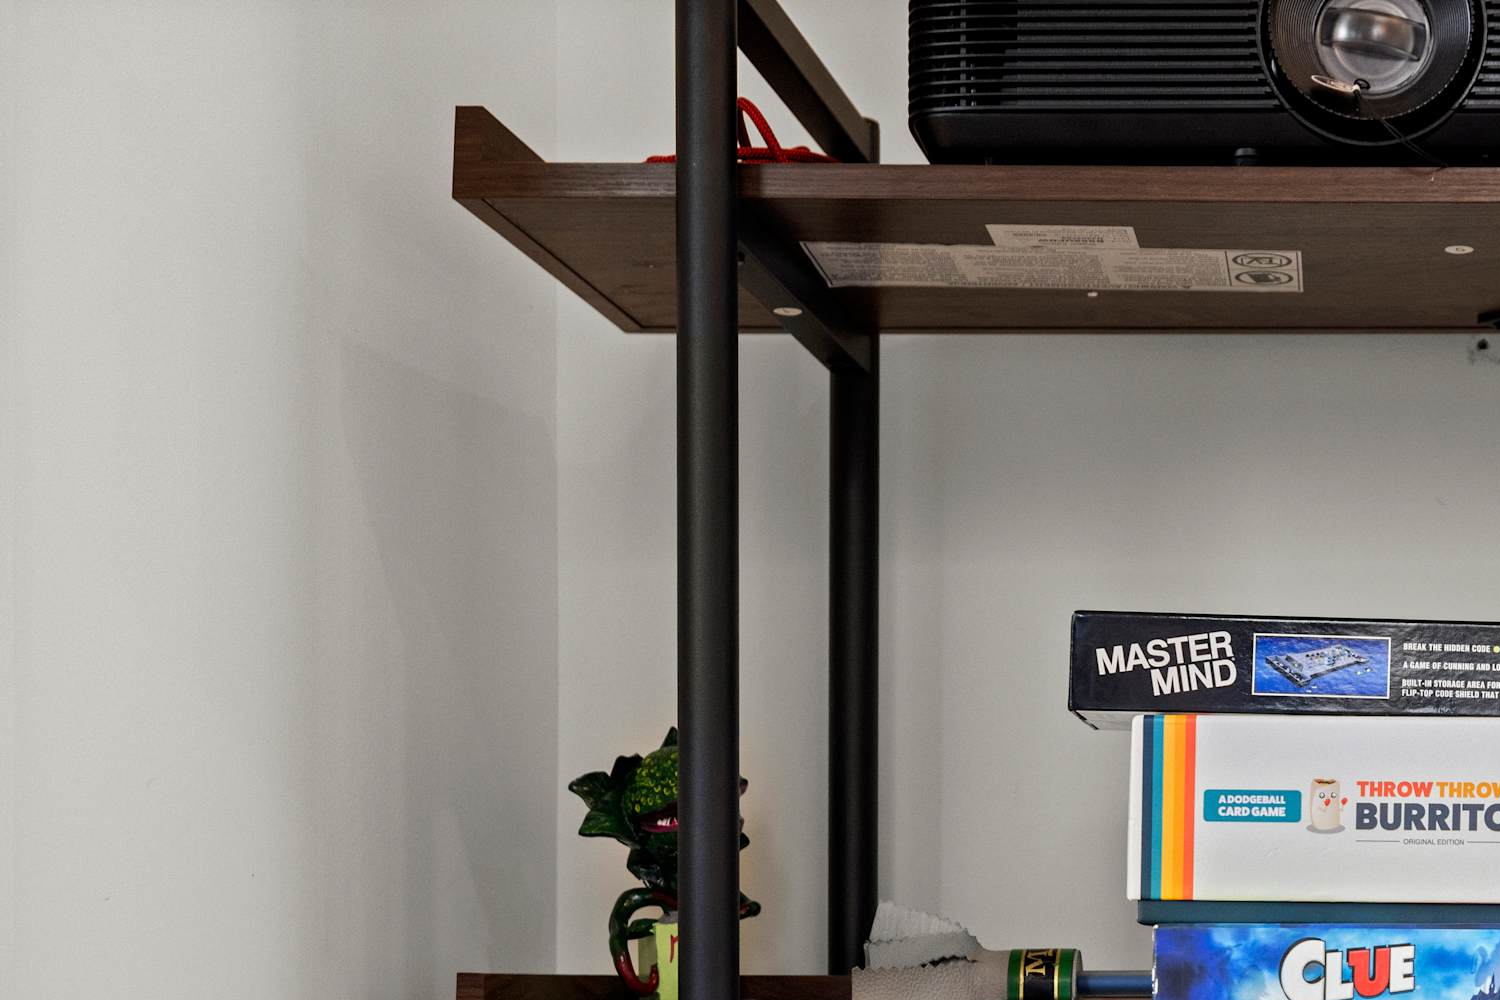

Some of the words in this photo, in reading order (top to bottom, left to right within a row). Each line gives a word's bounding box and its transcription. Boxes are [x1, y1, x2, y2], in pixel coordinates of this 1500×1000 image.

[1095, 630, 1233, 676] MASTER
[1403, 643, 1426, 651] BREAK
[1443, 644, 1470, 652] HIDDEN
[1472, 644, 1490, 653] CODE
[1410, 662, 1430, 670] GAME
[1432, 662, 1442, 670] OF
[1443, 662, 1474, 671] CUNNING
[1476, 663, 1490, 671] AND
[1151, 659, 1237, 697] MIND
[1402, 679, 1432, 688] BUILT-IN
[1434, 680, 1465, 688] STORAGE
[1466, 681, 1485, 689] AREA
[1402, 689, 1433, 698] FLIP-TOP
[1435, 690, 1454, 698] CODE
[1455, 691, 1480, 699] SHIELD
[1481, 691, 1499, 699] THAT
[1356, 781, 1433, 798] THROW
[1218, 795, 1228, 805] A
[1228, 794, 1286, 805] DODGEBALL
[1218, 806, 1250, 817] CARD
[1252, 806, 1286, 817] GAME
[1403, 838, 1436, 846] ORIGINAL
